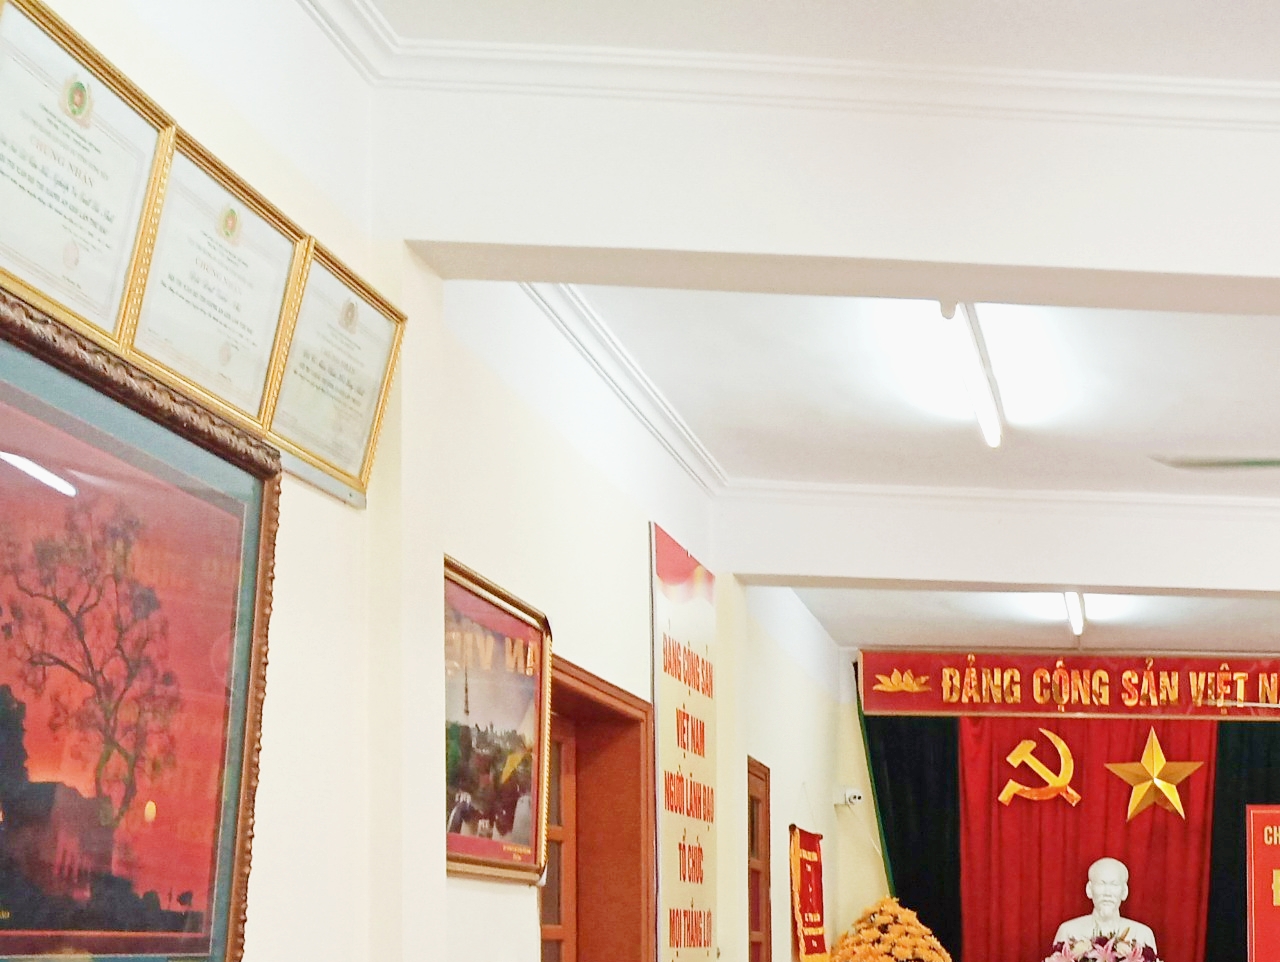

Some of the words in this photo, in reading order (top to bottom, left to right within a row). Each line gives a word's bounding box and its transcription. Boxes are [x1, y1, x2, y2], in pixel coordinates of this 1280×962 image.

[941, 654, 1021, 704] ĐẢNG
[1033, 657, 1110, 712] CỘNG
[1121, 657, 1179, 707] SẢN
[1189, 663, 1249, 714] VIỆT
